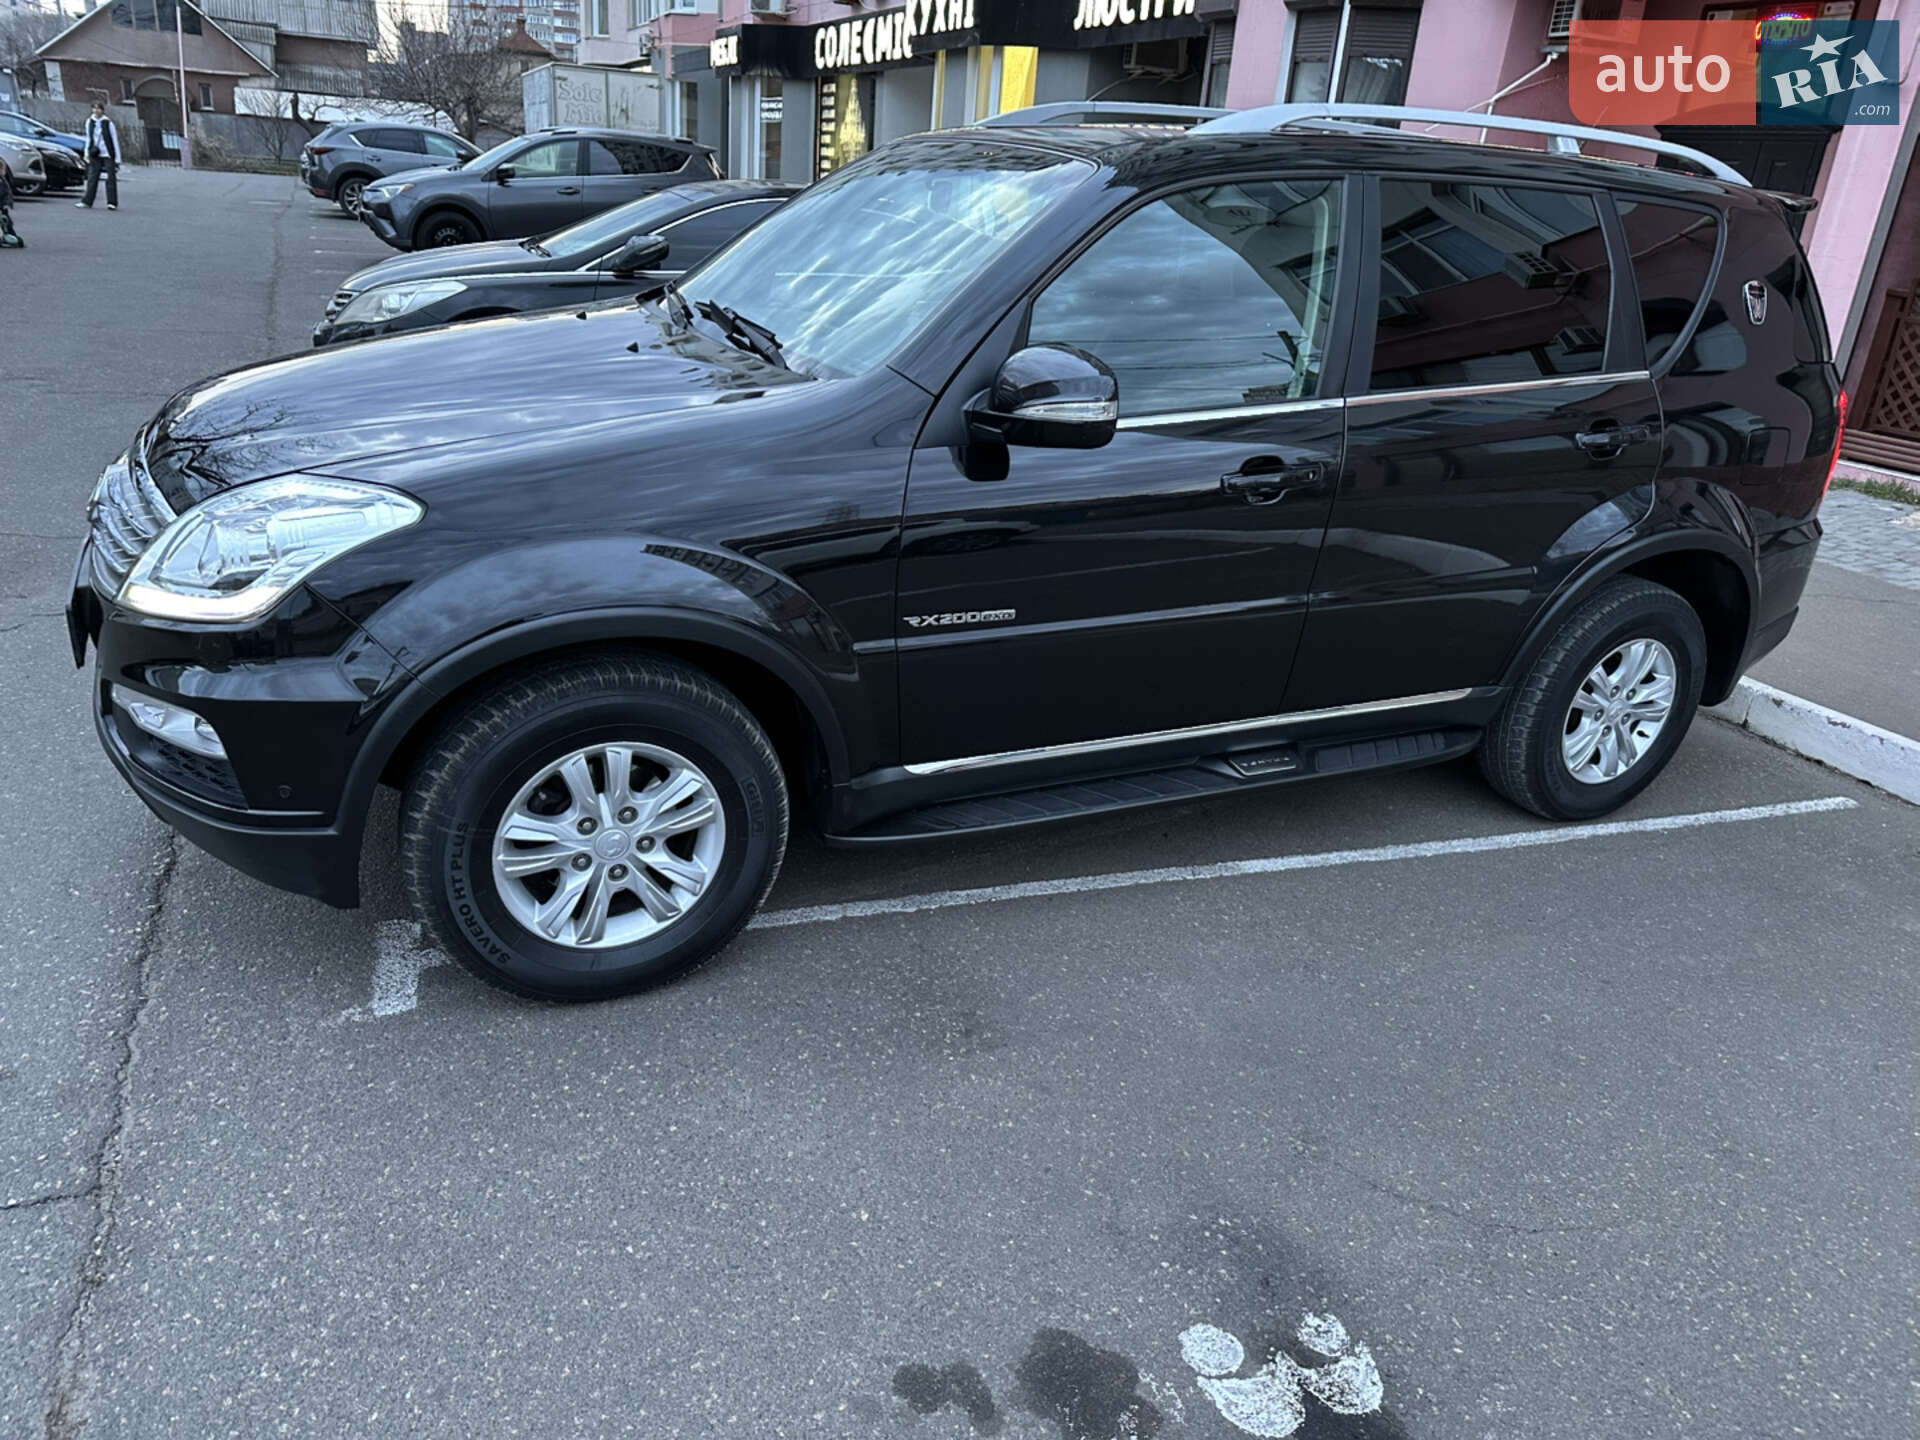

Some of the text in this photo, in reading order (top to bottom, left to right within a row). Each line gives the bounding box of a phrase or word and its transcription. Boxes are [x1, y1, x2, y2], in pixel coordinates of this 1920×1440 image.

[451, 823, 511, 964] SAVERO HT PLUS
